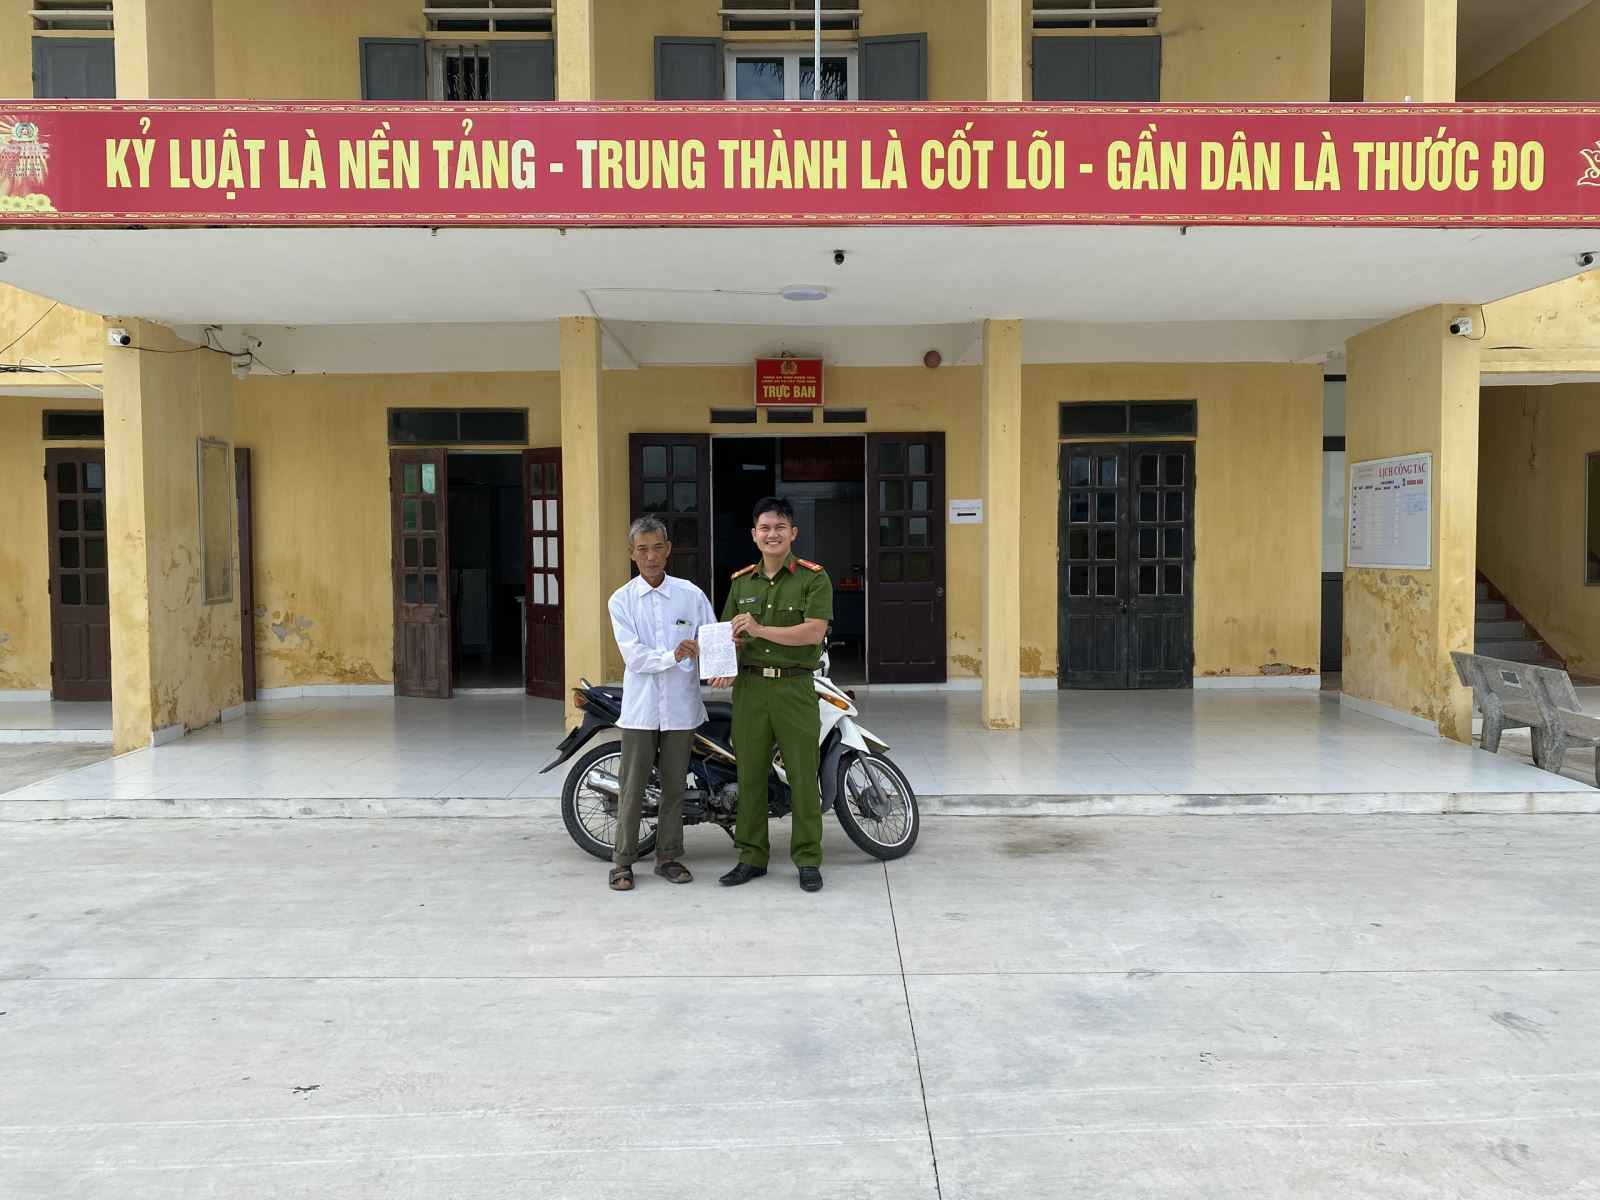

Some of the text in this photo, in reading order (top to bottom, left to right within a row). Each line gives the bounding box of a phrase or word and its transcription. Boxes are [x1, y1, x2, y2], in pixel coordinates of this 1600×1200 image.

[106, 117, 1545, 200] KỶ LUẬT LÀ NỀN TẢNG - TRUNG THÀNH LÀ CỐT LÕI - GẦN DÂN LÀ THƯỚC ĐO
[762, 384, 816, 400] TRỰC BAN
